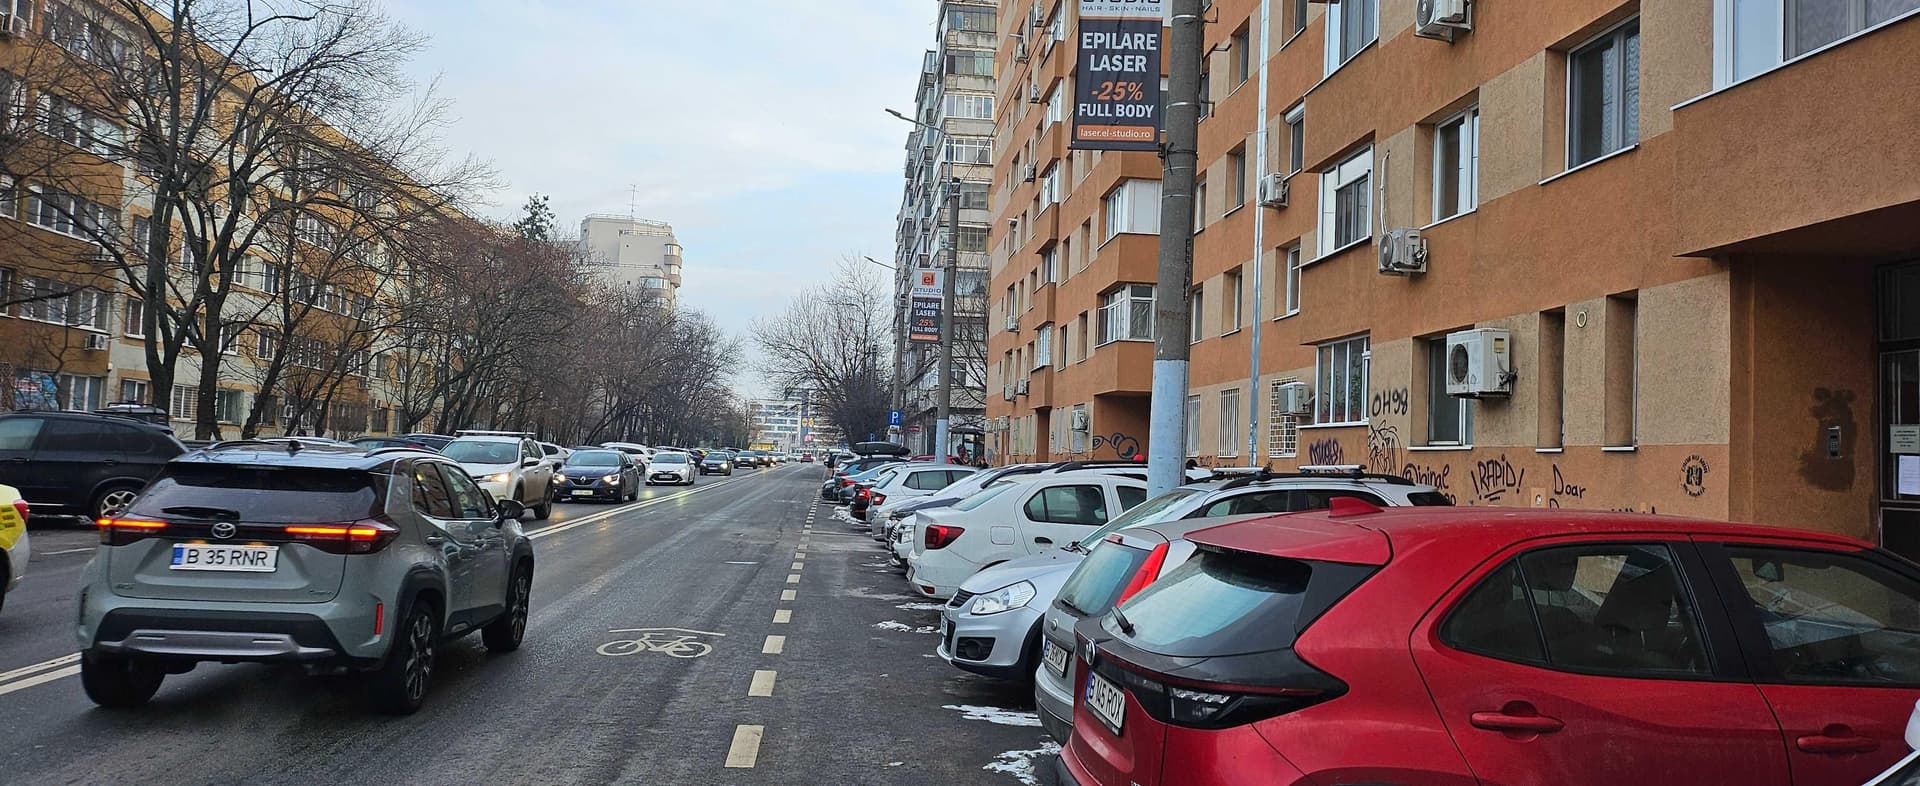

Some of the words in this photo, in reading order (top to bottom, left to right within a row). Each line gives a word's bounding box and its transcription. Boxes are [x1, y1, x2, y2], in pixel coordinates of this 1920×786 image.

[1082, 32, 1158, 51] EPILARE
[1089, 54, 1147, 73] LASER
[1092, 81, 1144, 101] -25%
[1078, 103, 1113, 117] FULL
[1115, 104, 1154, 118] BODY
[1080, 128, 1151, 138] laser.el-studio.ro
[913, 301, 940, 310] EPILARE
[915, 309, 936, 317] LASER
[892, 411, 899, 424] P
[1552, 463, 1587, 499] Doar
[187, 549, 200, 564] B
[206, 549, 226, 565] 35
[230, 550, 269, 566] RNR
[1089, 674, 1096, 699] B
[1106, 687, 1124, 723] ROX
